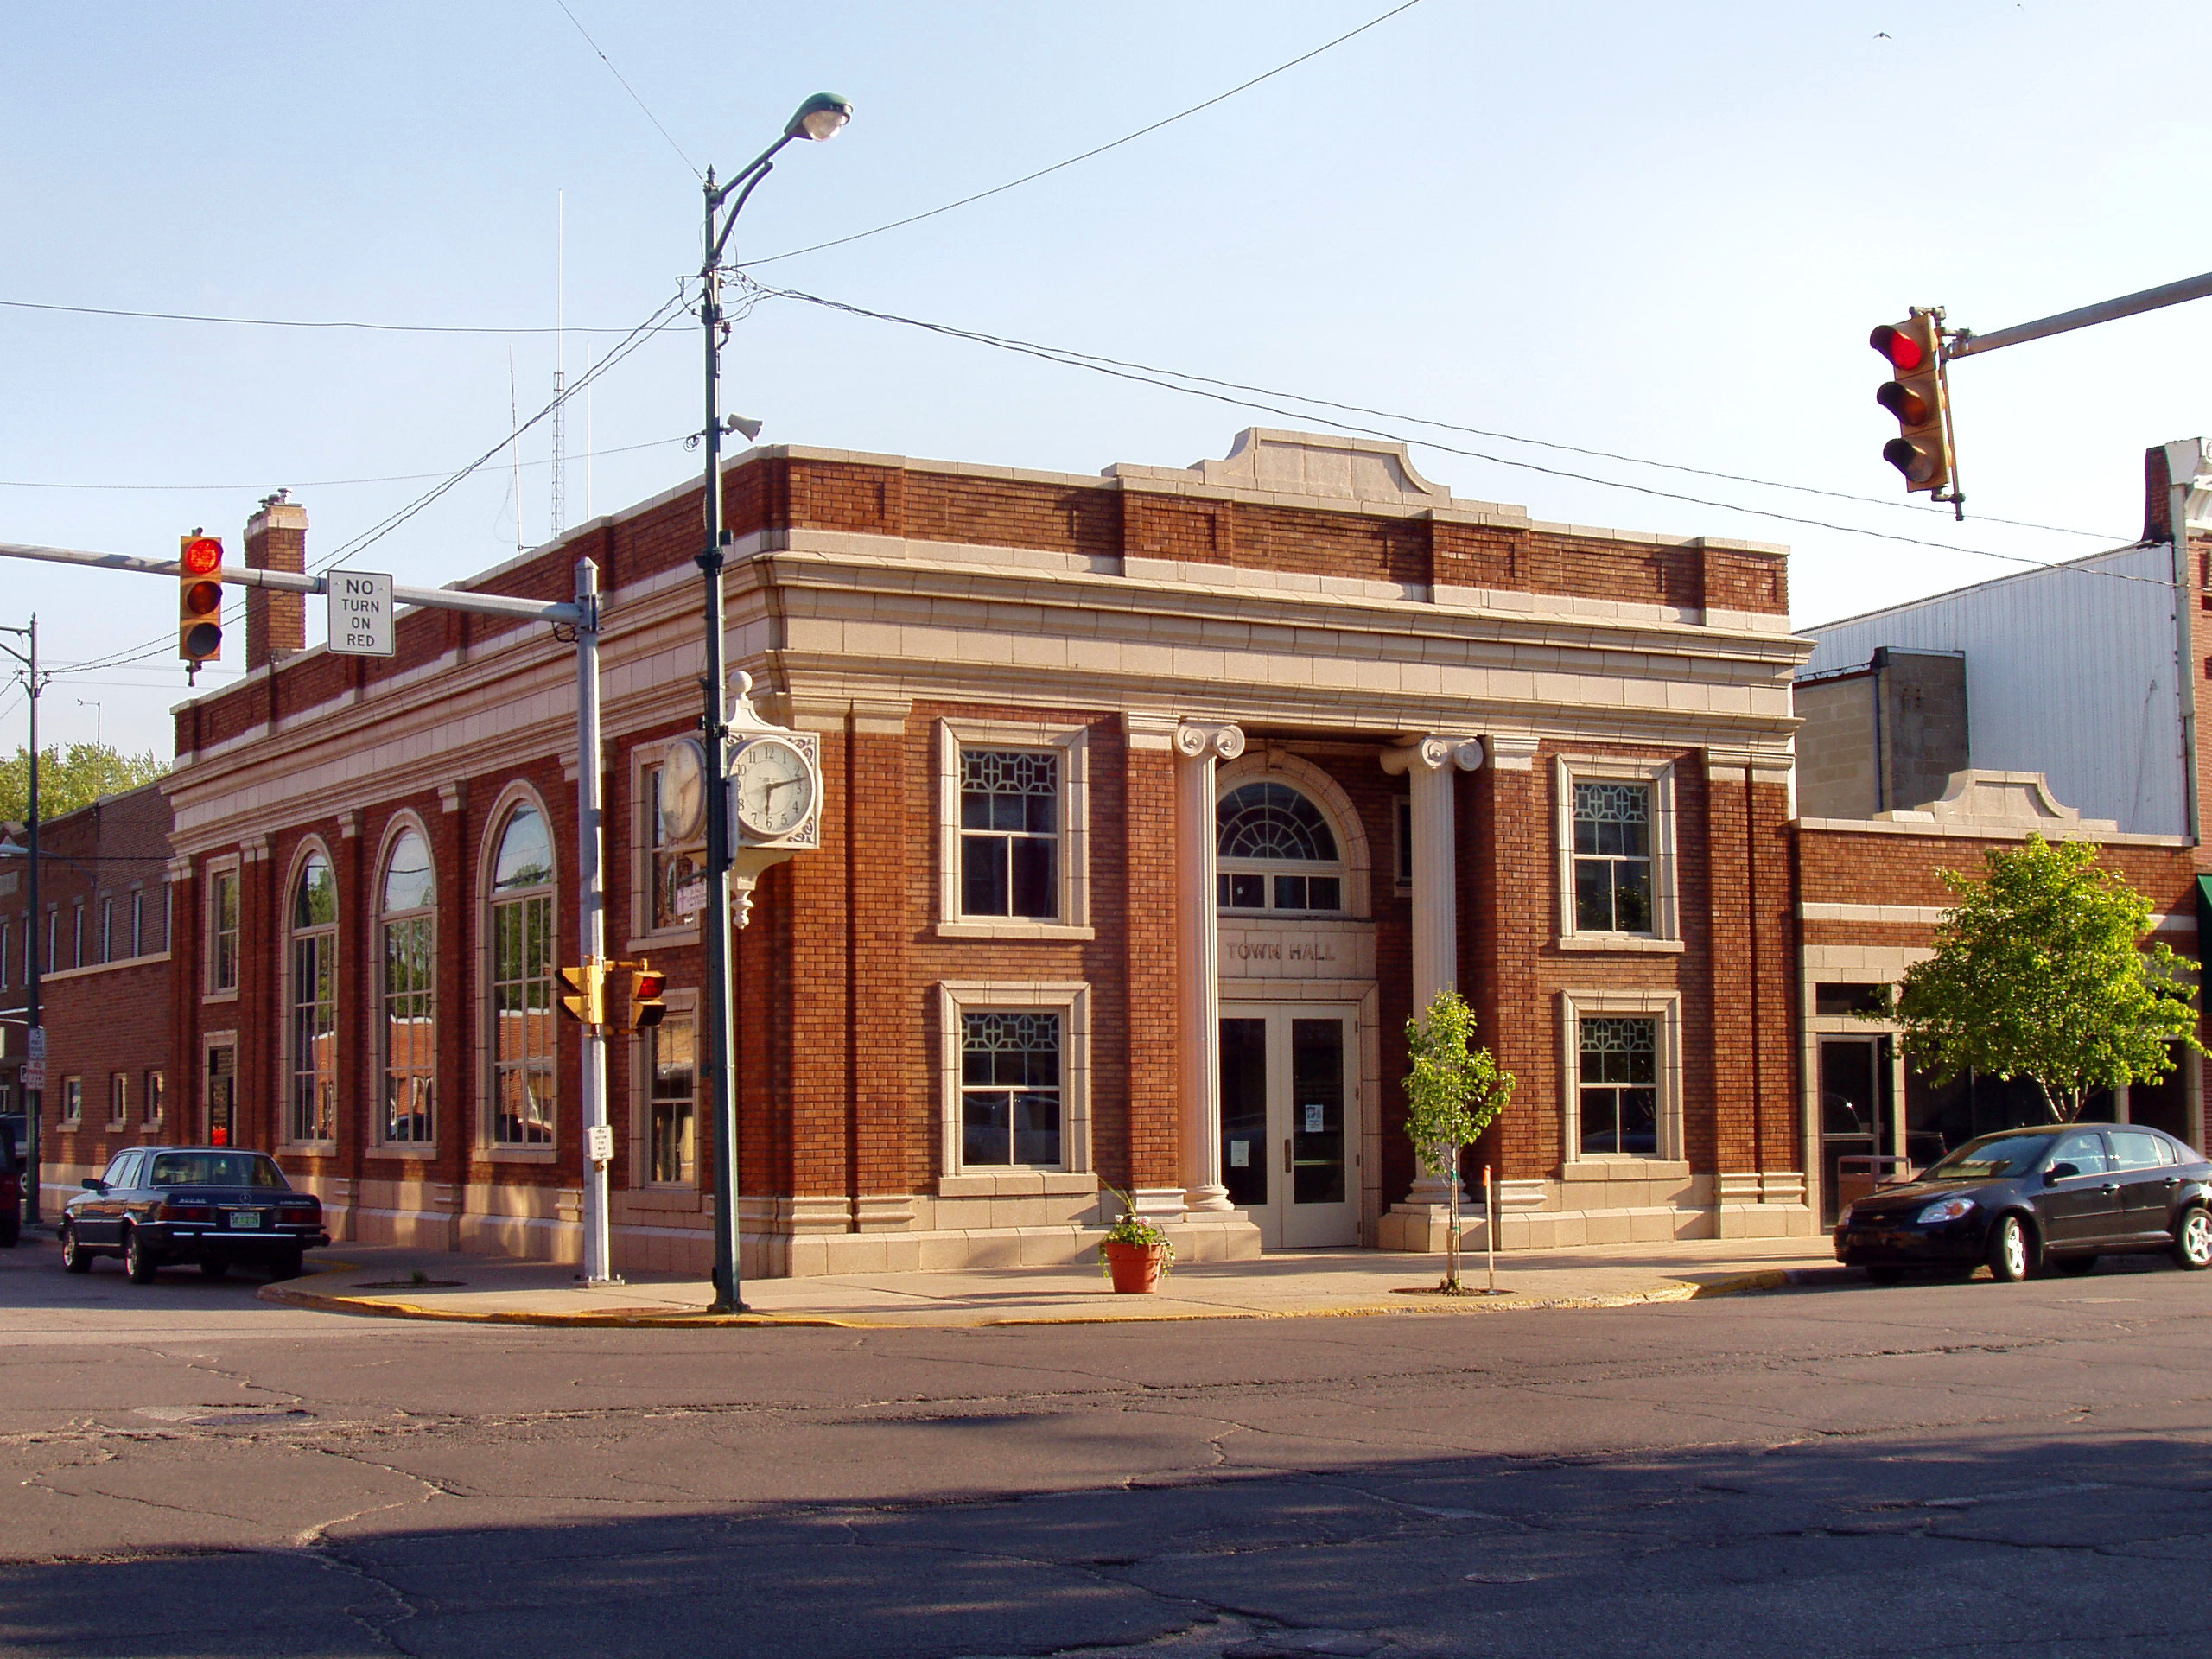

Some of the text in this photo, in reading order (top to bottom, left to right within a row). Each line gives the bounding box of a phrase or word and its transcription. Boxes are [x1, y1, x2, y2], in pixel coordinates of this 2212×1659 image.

[346, 578, 373, 594] NO
[342, 598, 379, 613] TURN
[352, 617, 370, 629] ON
[347, 633, 375, 647] RED
[748, 750, 756, 764] 11
[765, 747, 774, 760] 12
[782, 753, 786, 764] 1
[736, 764, 747, 775] 10
[794, 765, 800, 777] 2
[738, 798, 745, 811] 8
[792, 801, 799, 813] 4
[751, 812, 758, 825] 7
[766, 816, 772, 829] 6
[781, 813, 788, 825] 5
[1227, 943, 1336, 961] TOWN HALL
